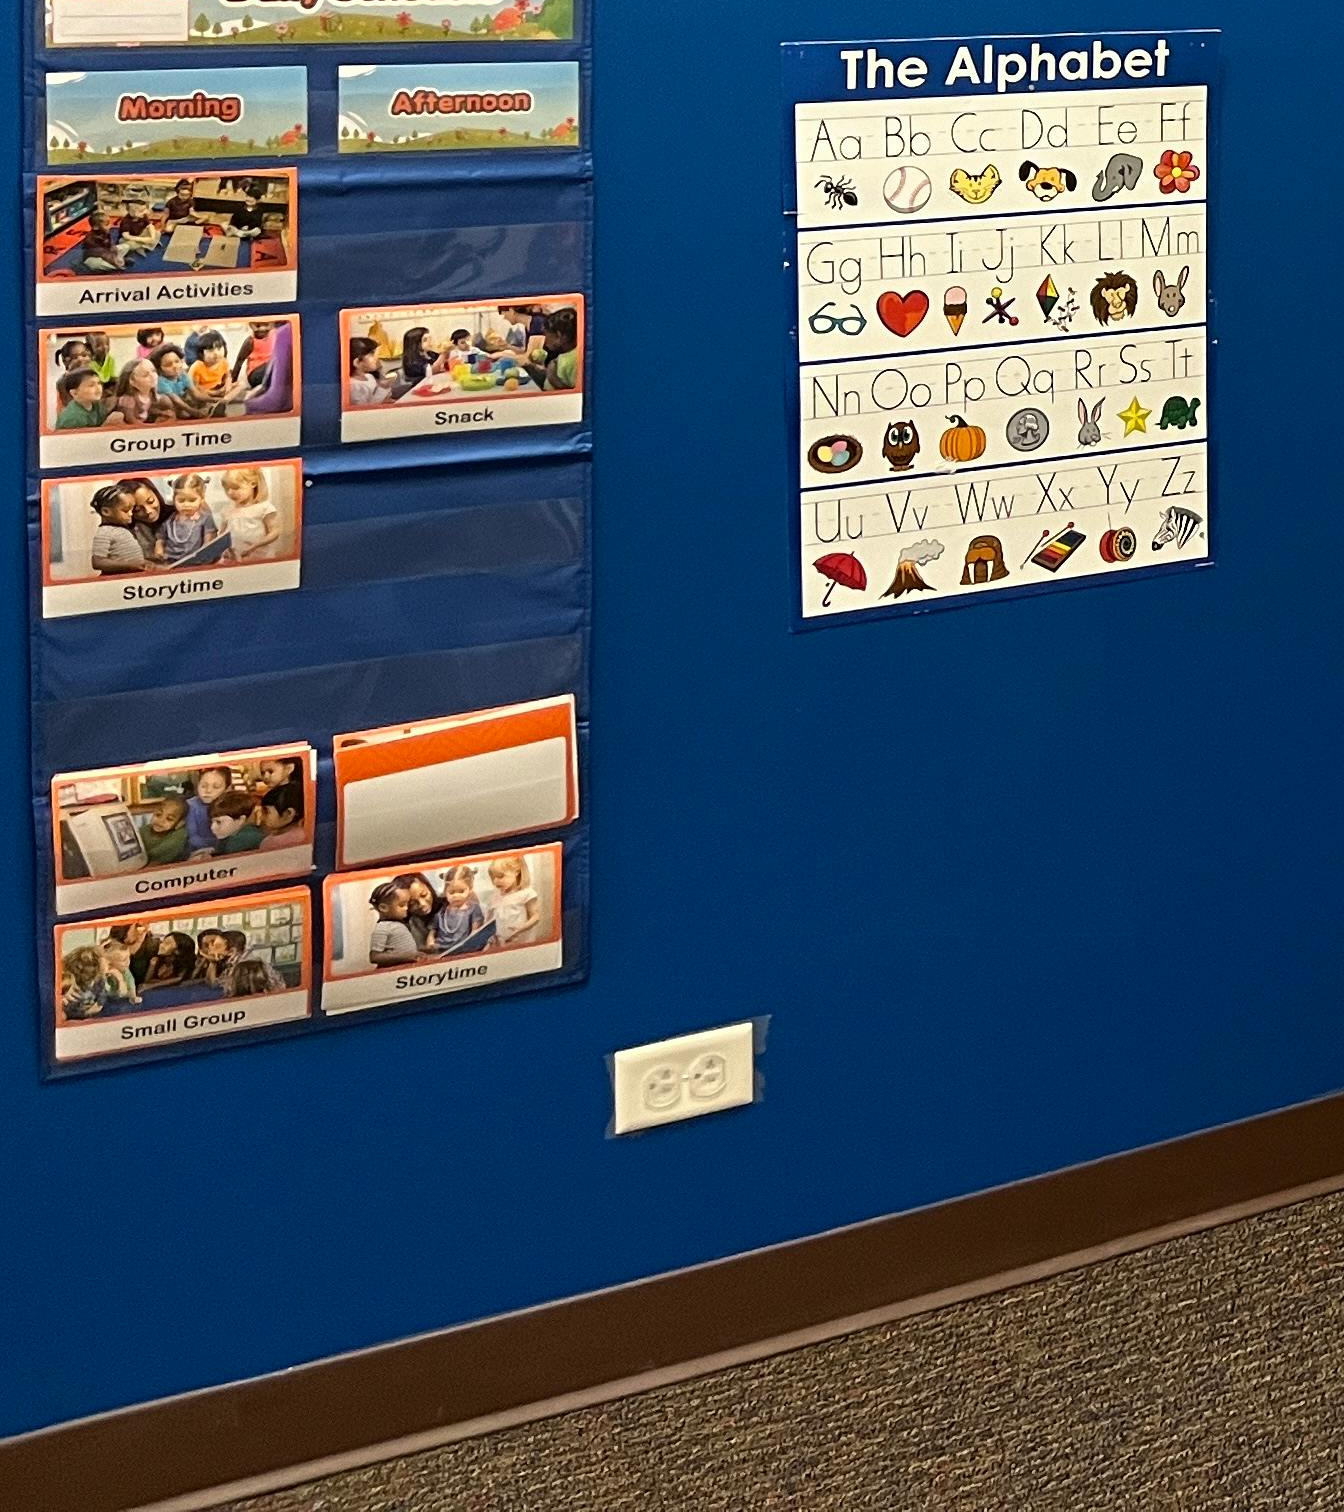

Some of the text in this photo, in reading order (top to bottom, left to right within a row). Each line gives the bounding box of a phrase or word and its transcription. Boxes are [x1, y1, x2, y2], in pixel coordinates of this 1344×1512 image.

[840, 39, 1169, 92] The Alphabet
[118, 92, 242, 123] Morning
[390, 89, 532, 116] Afternoon
[809, 102, 1191, 163] Aa Bb Cc Dd Ee Ff
[806, 241, 862, 296] Gg
[880, 236, 927, 279] Hh
[946, 232, 963, 274] Ii
[981, 228, 1015, 284] Jj
[1041, 223, 1076, 266] Kk
[1142, 216, 1200, 257] Mm
[78, 283, 253, 305] Arrival Activities
[812, 339, 1195, 419] Nn Oo Pp Qq Rr Ss Tt
[435, 408, 493, 425] Snack
[109, 430, 232, 455] Group Time
[814, 456, 1197, 543] Uu Vv Ww Xx Yy Zz
[122, 576, 225, 602] Storytime
[134, 864, 238, 895] Computer
[395, 961, 489, 991] Storytime
[120, 1007, 246, 1041] Small Group
